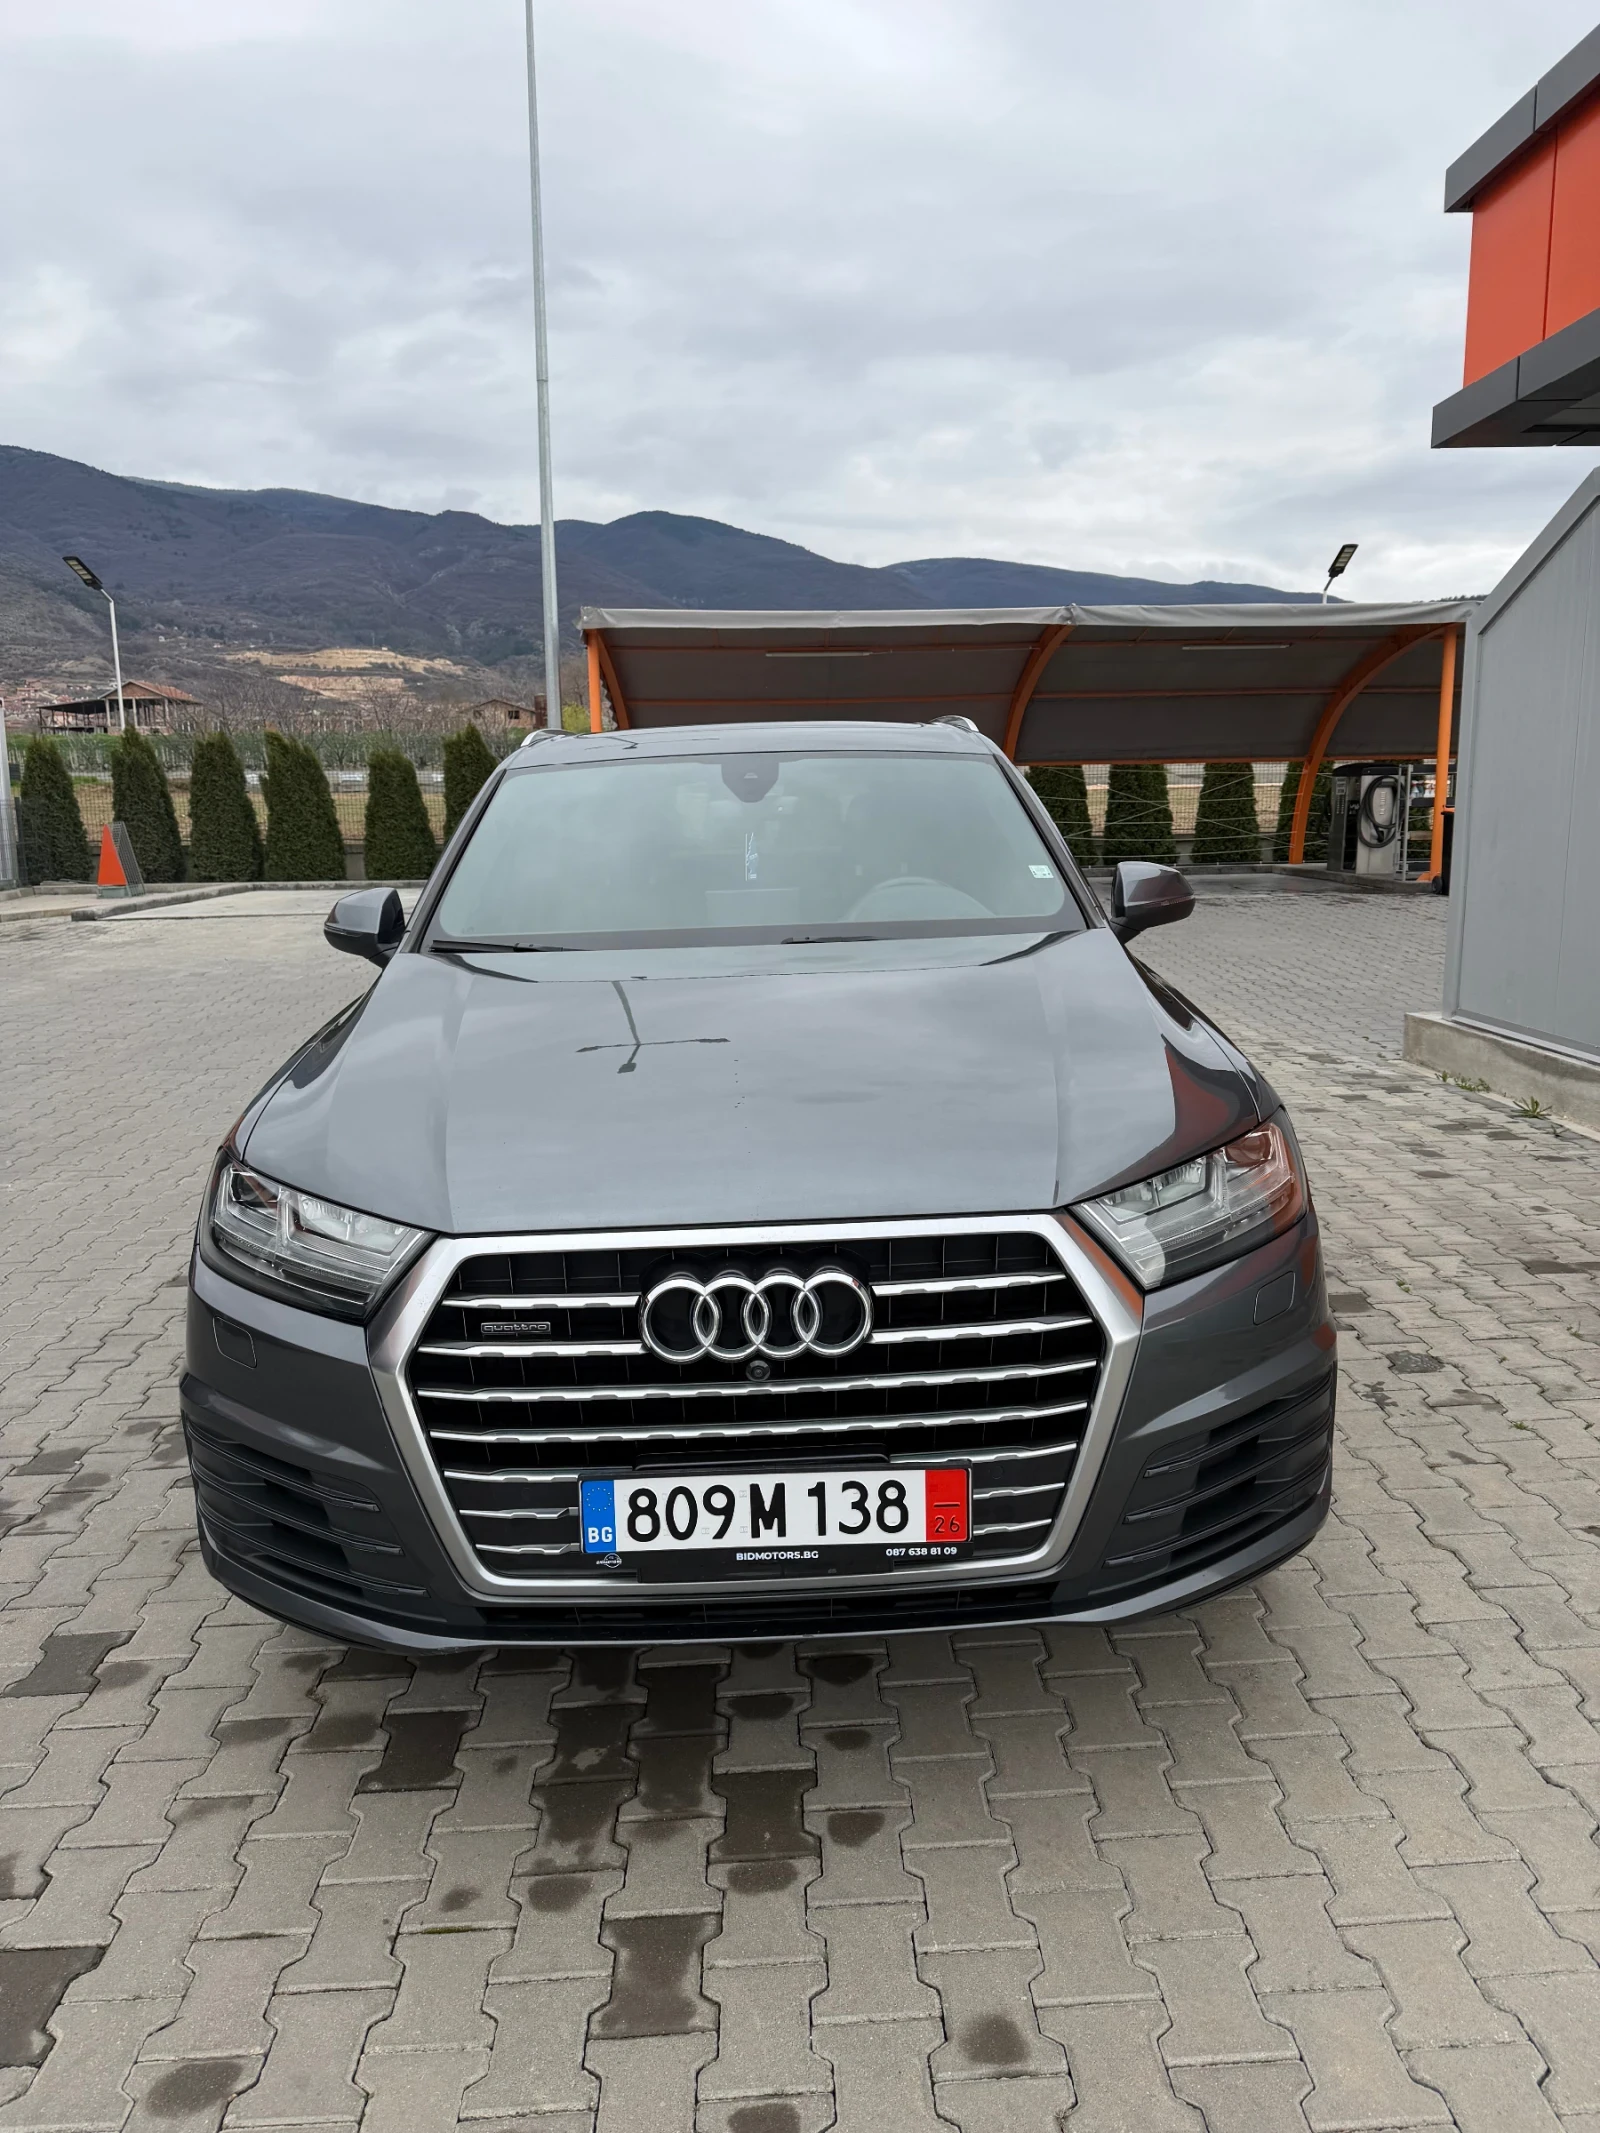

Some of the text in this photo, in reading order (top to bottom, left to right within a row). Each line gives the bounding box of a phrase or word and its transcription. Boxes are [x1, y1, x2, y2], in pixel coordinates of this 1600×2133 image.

[483, 1324, 547, 1332] quattro
[627, 1479, 909, 1542] 809 M 138
[934, 1515, 960, 1534] 26
[588, 1527, 612, 1543] BG
[736, 1550, 819, 1560] BIDMOTORS.BG
[885, 1546, 958, 1556] 087 638 81 09
